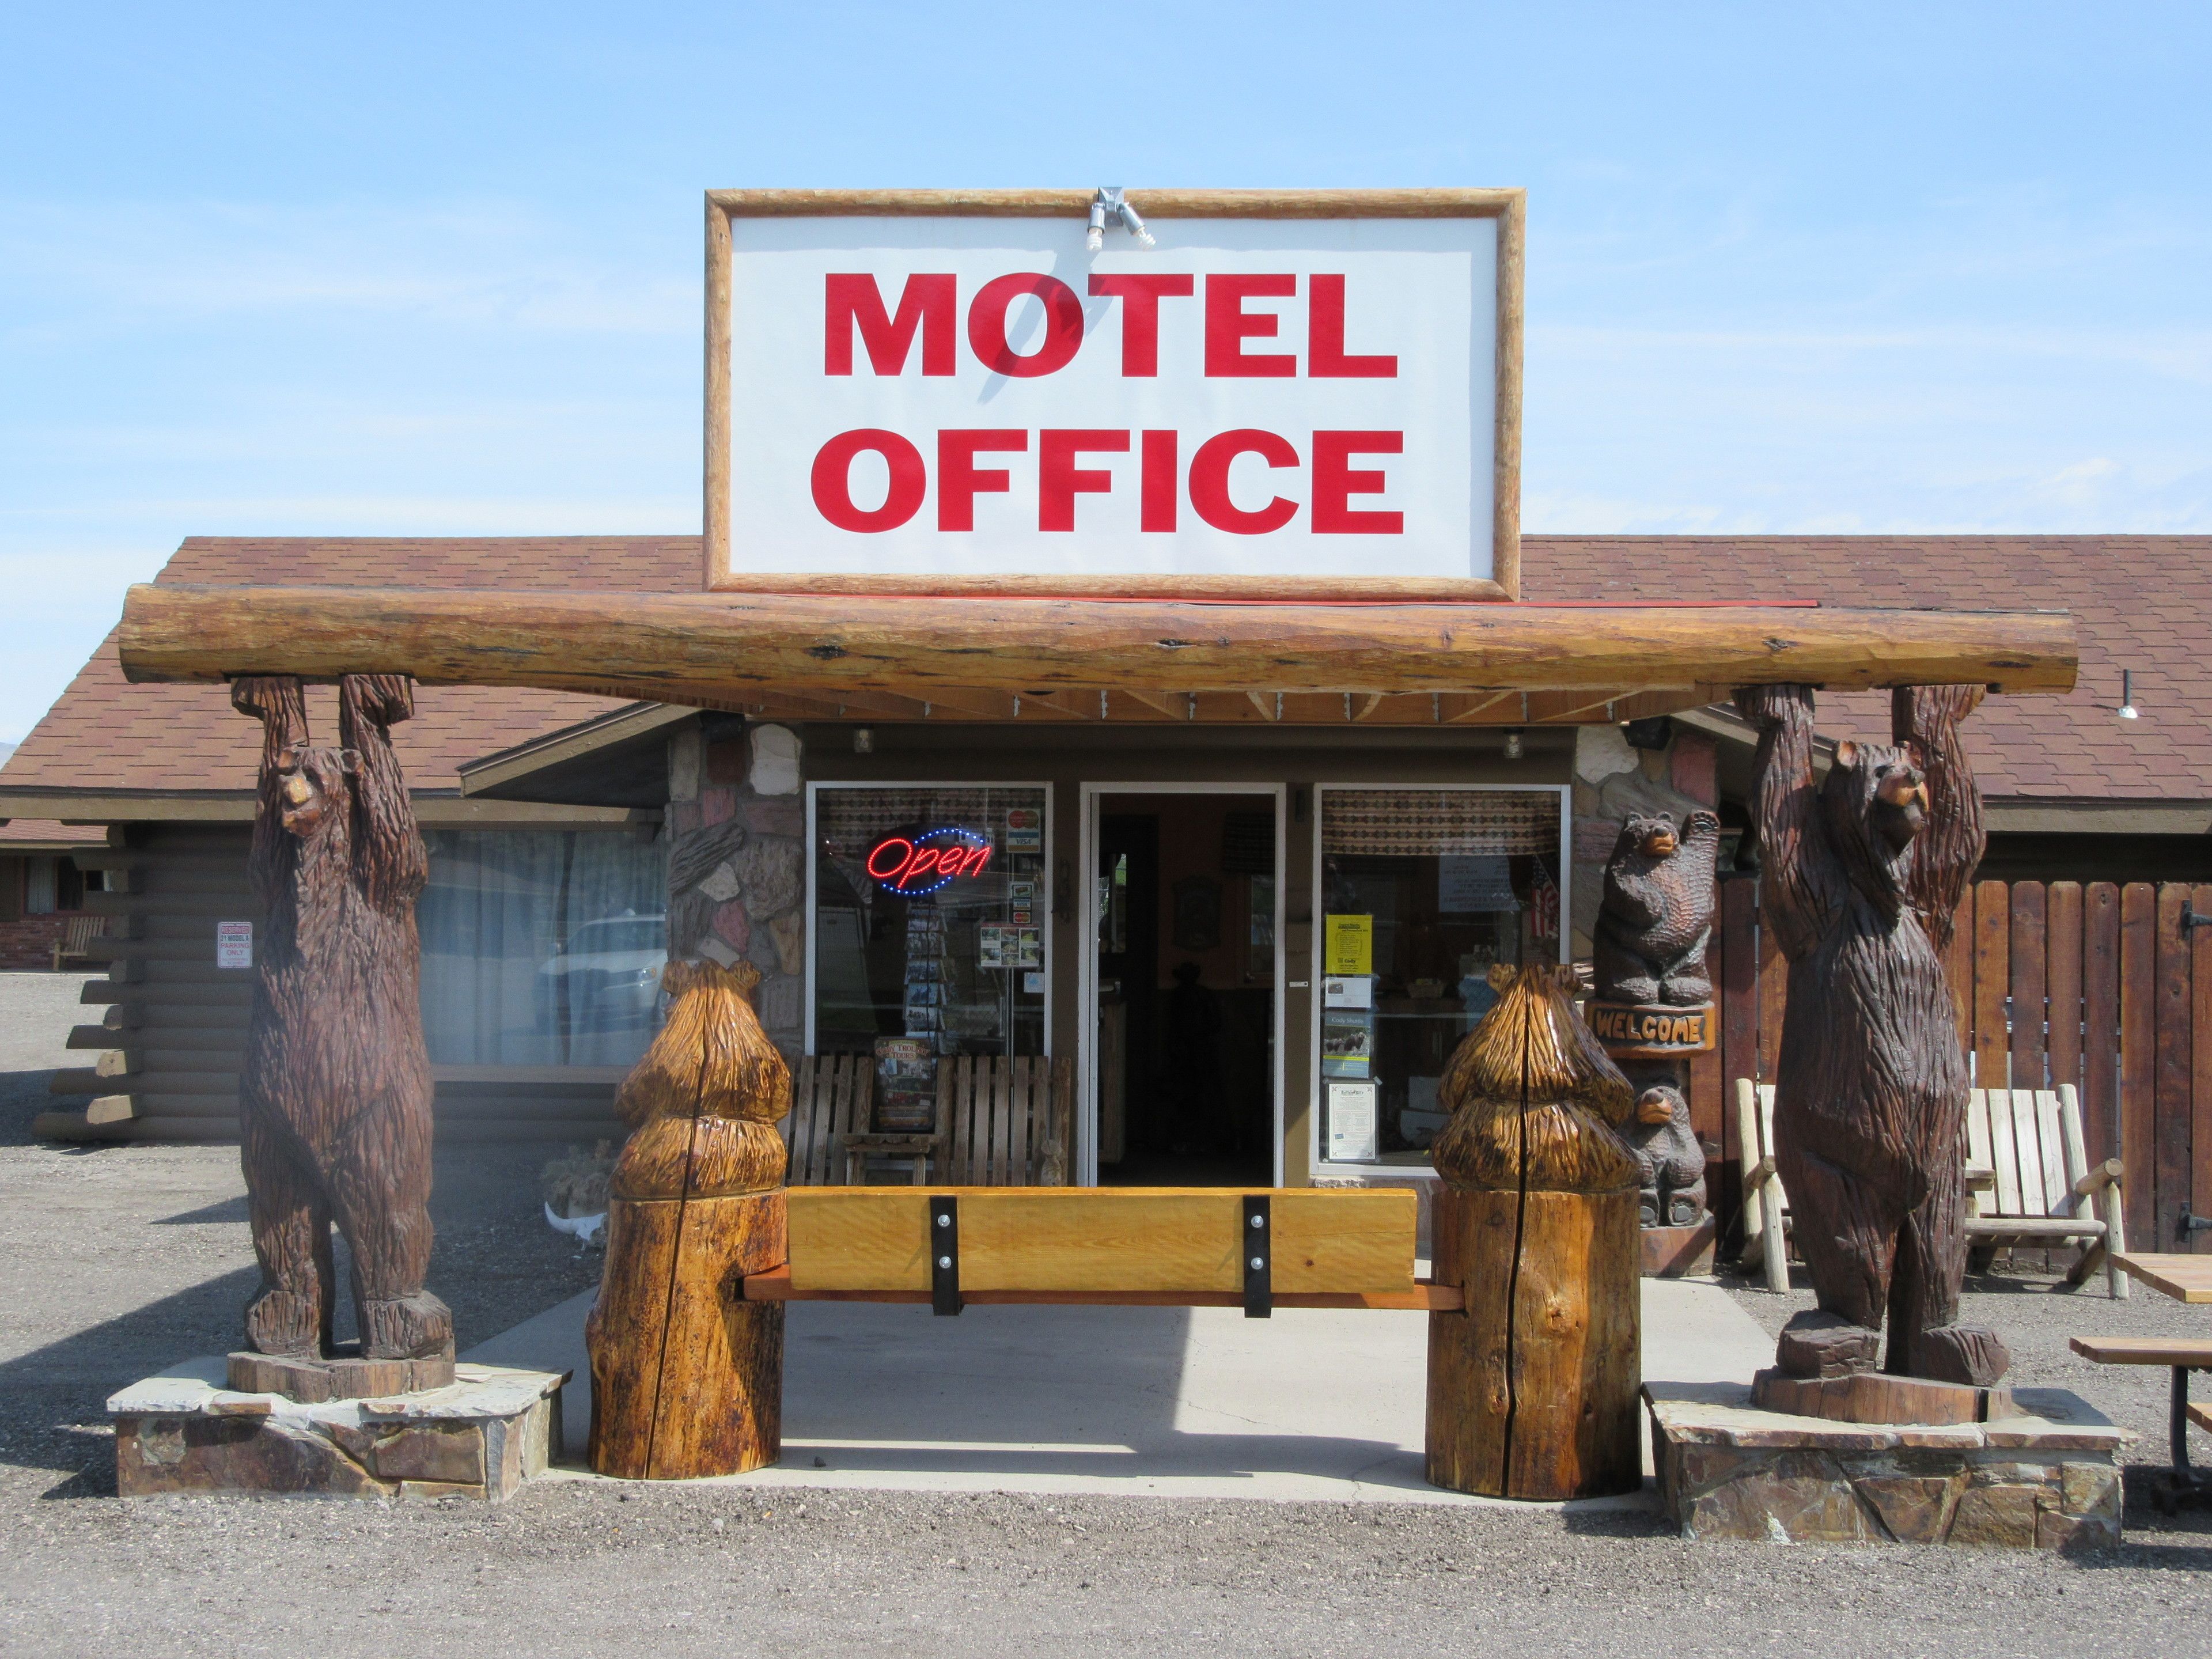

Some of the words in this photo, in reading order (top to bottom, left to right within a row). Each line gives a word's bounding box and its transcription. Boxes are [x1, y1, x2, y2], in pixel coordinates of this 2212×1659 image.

[824, 271, 1398, 378] MOTEL
[810, 428, 1404, 535] OFFICE
[867, 838, 991, 889] Open
[1596, 1010, 1704, 1043] WELCOME
